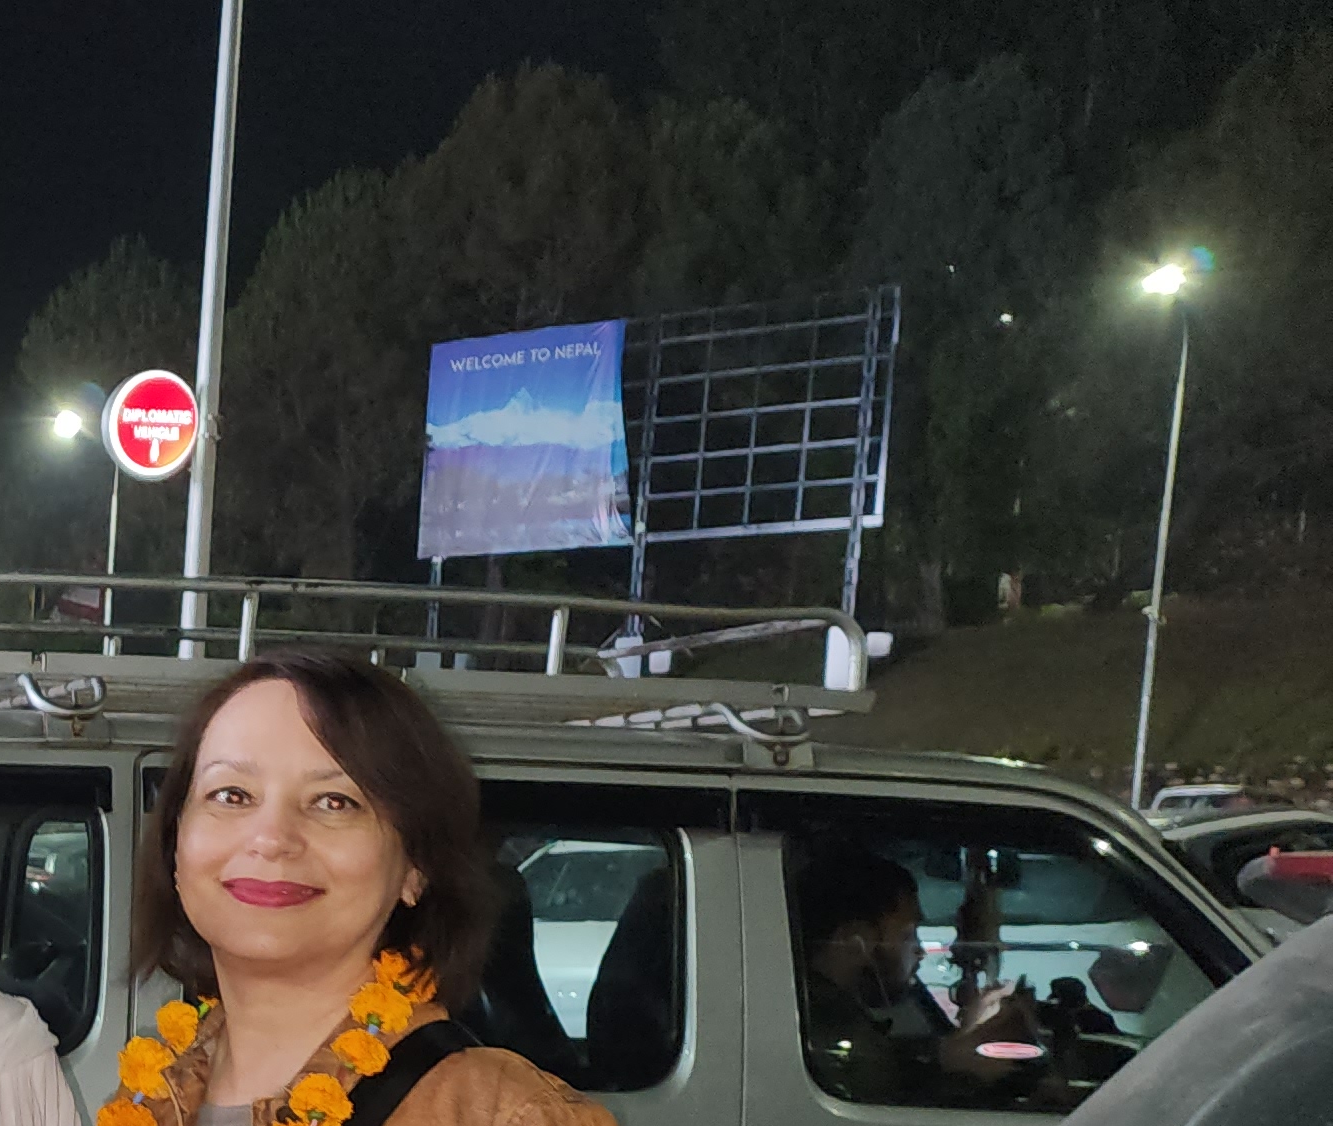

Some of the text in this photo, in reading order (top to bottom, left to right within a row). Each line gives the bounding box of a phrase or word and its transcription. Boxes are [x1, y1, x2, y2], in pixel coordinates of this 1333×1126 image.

[450, 341, 601, 372] WELCOME TO NEPAL
